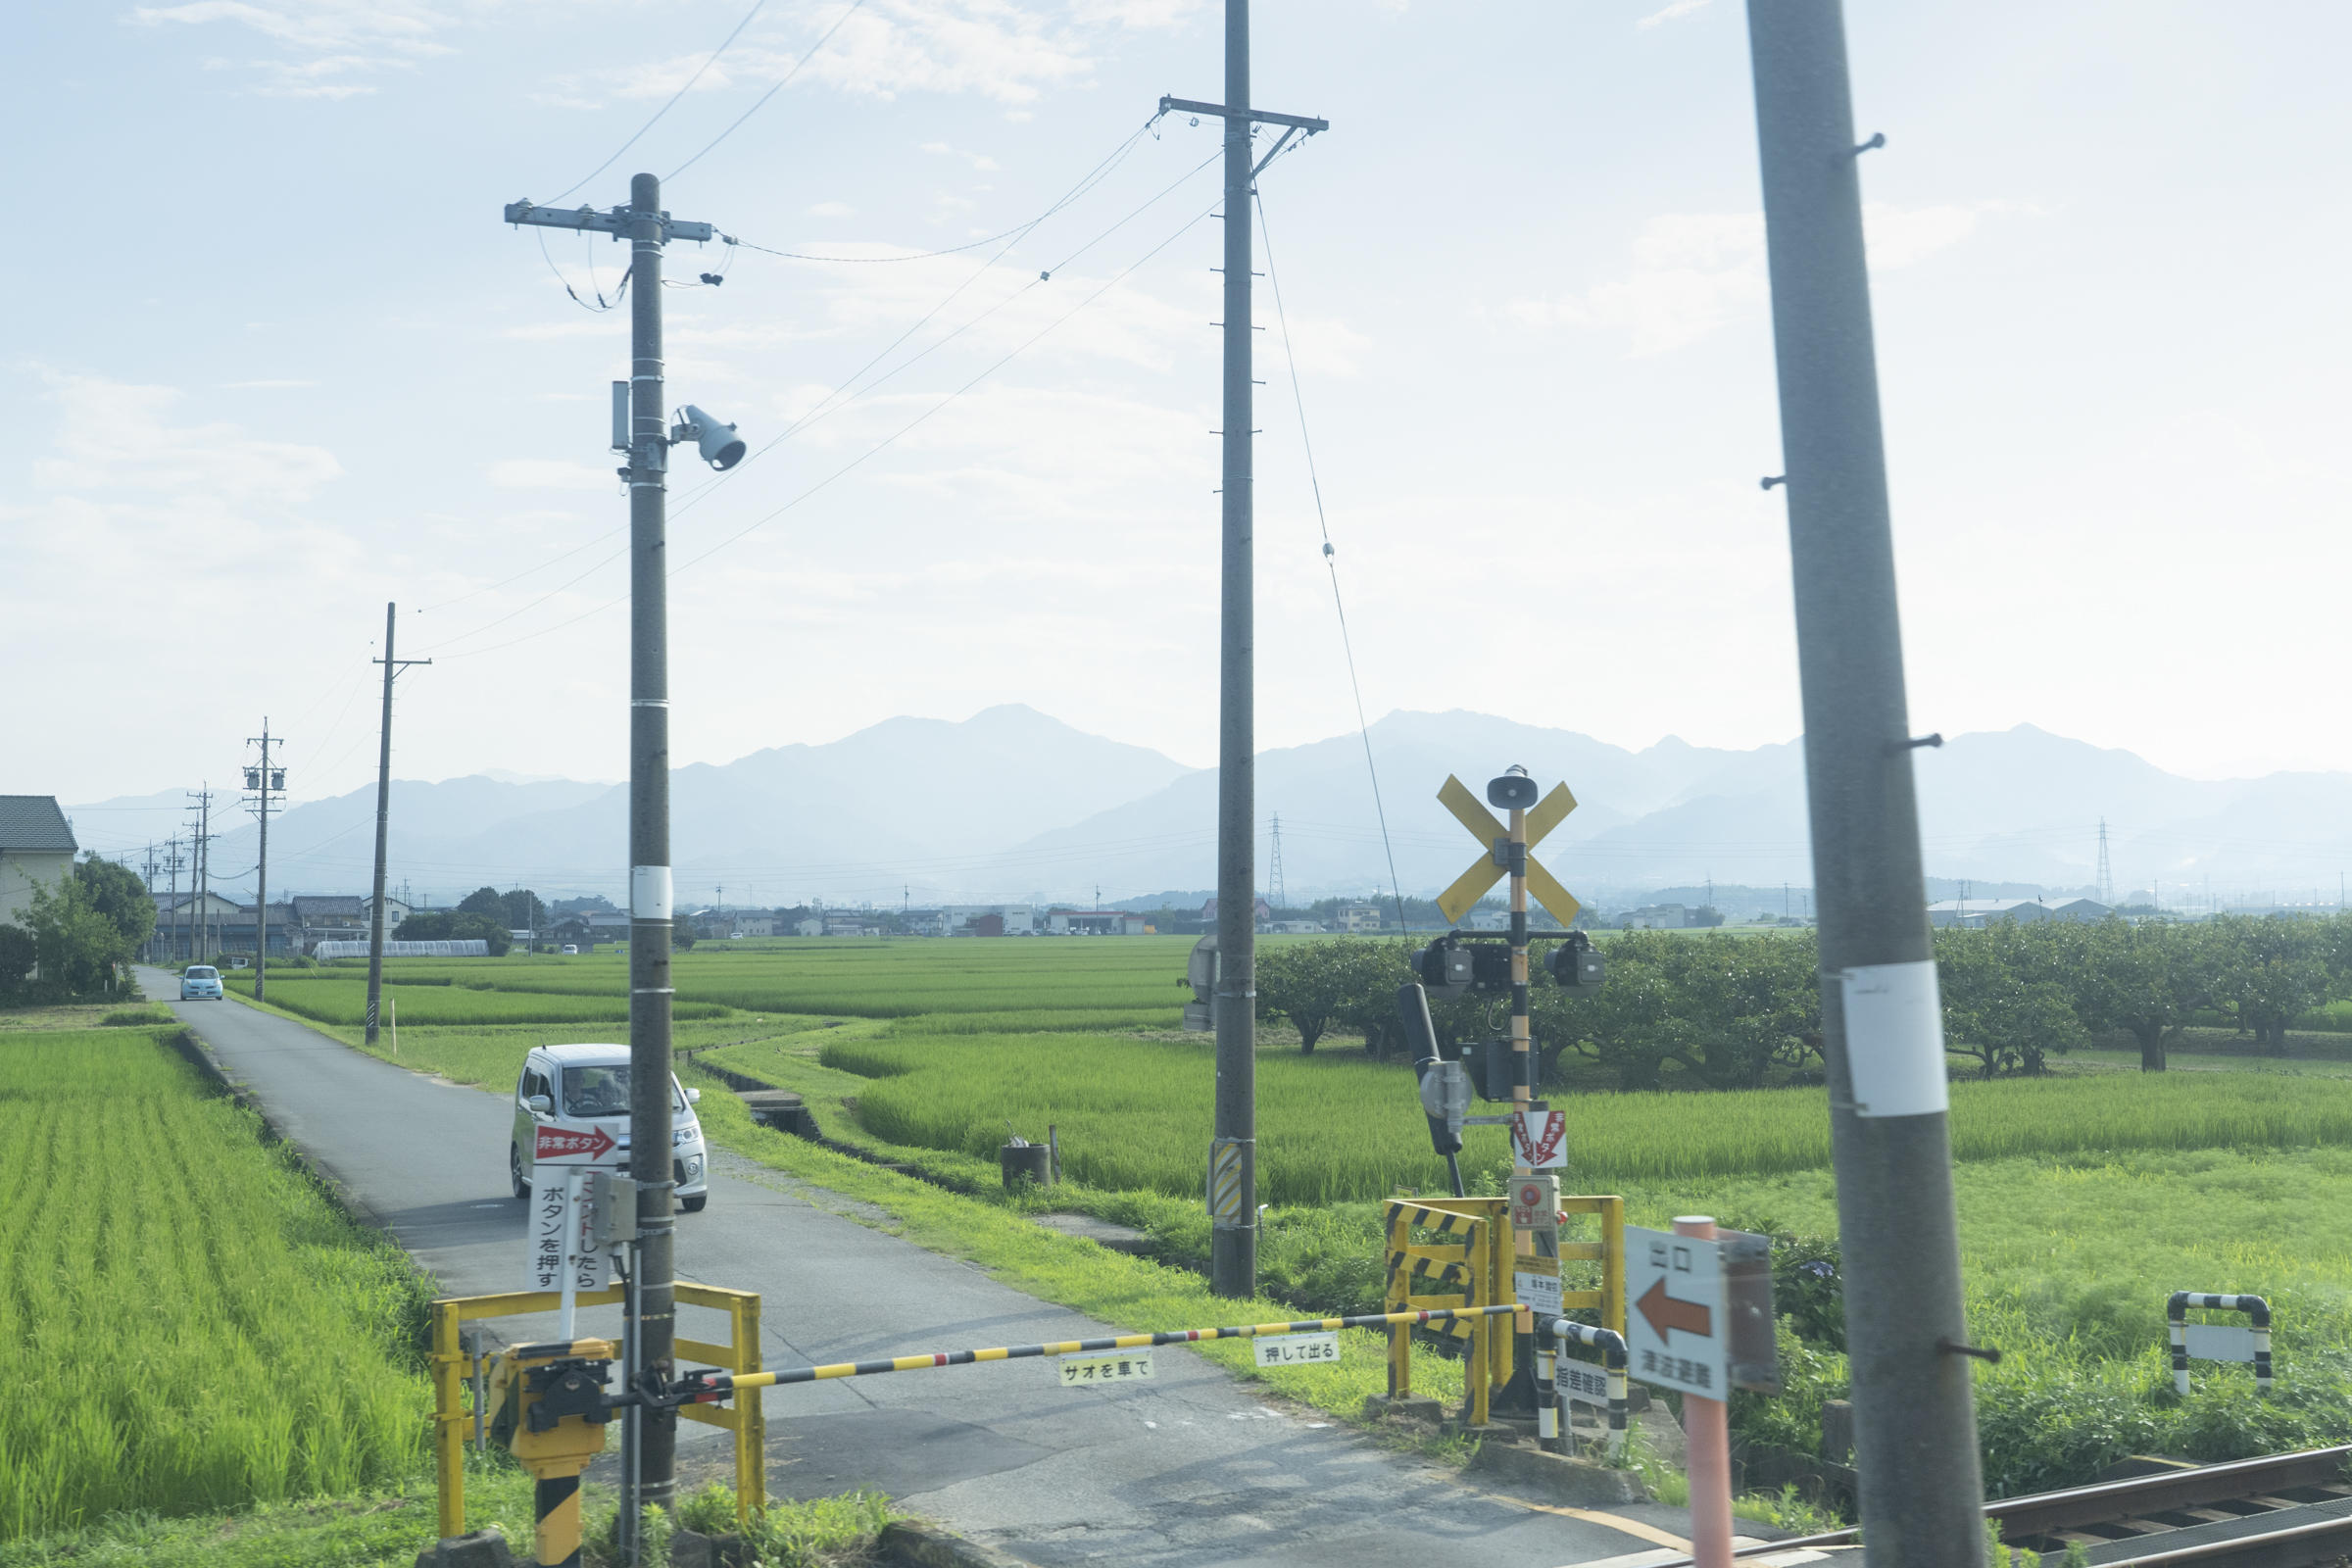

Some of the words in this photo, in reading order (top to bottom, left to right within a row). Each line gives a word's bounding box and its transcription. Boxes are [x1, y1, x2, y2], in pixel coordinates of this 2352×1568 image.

[538, 1135, 607, 1150] 非常ボタン
[536, 1187, 564, 1288] ボタンを押す
[1264, 1342, 1335, 1362] 押して出る
[1064, 1359, 1150, 1382] サオを車で
